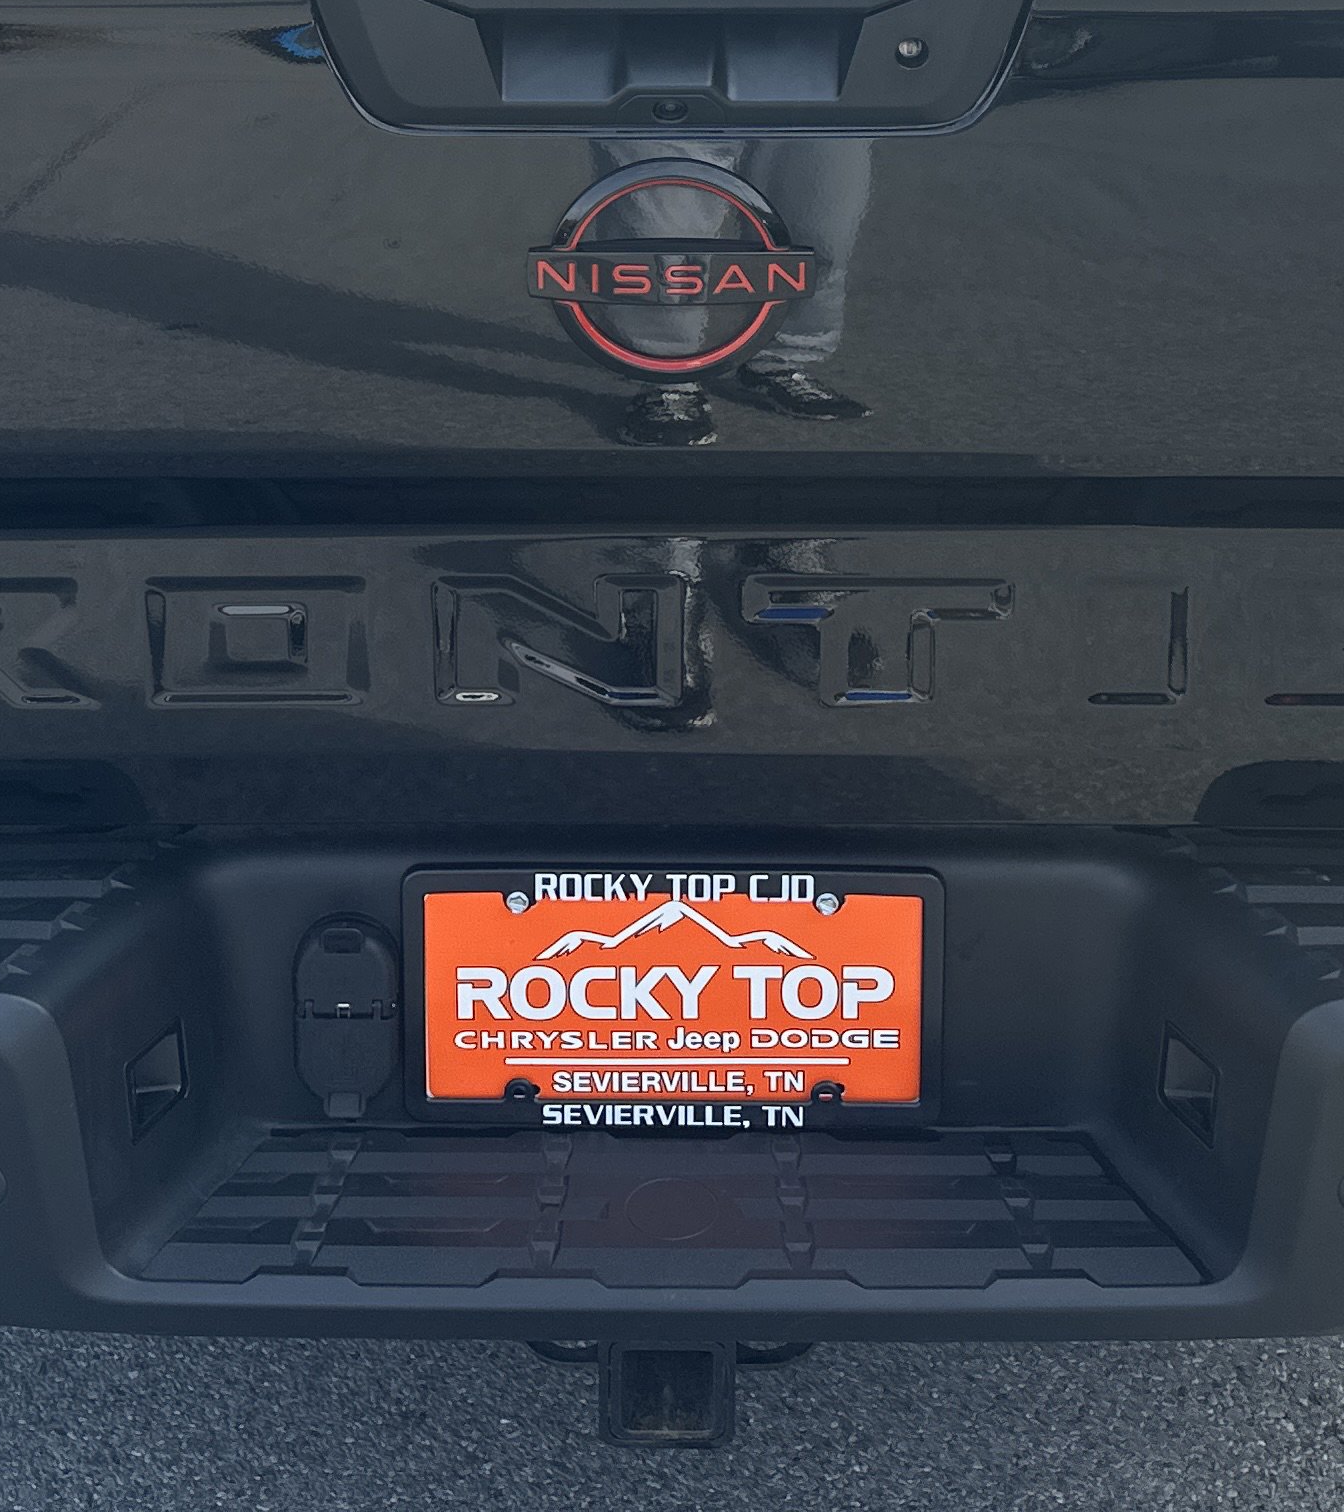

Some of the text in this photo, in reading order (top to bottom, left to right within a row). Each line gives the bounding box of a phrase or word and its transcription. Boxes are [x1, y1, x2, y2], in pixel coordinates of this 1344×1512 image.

[536, 260, 807, 296] NISSAN
[534, 873, 815, 903] ROCKY TOP CJD
[455, 965, 896, 1022] ROCKY TOP
[453, 1026, 900, 1053] CHRYSLER Jeep DODGE
[551, 1071, 805, 1096] SEVIERVILLE, TN
[541, 1105, 805, 1130] SEVIERVILLE, TN
